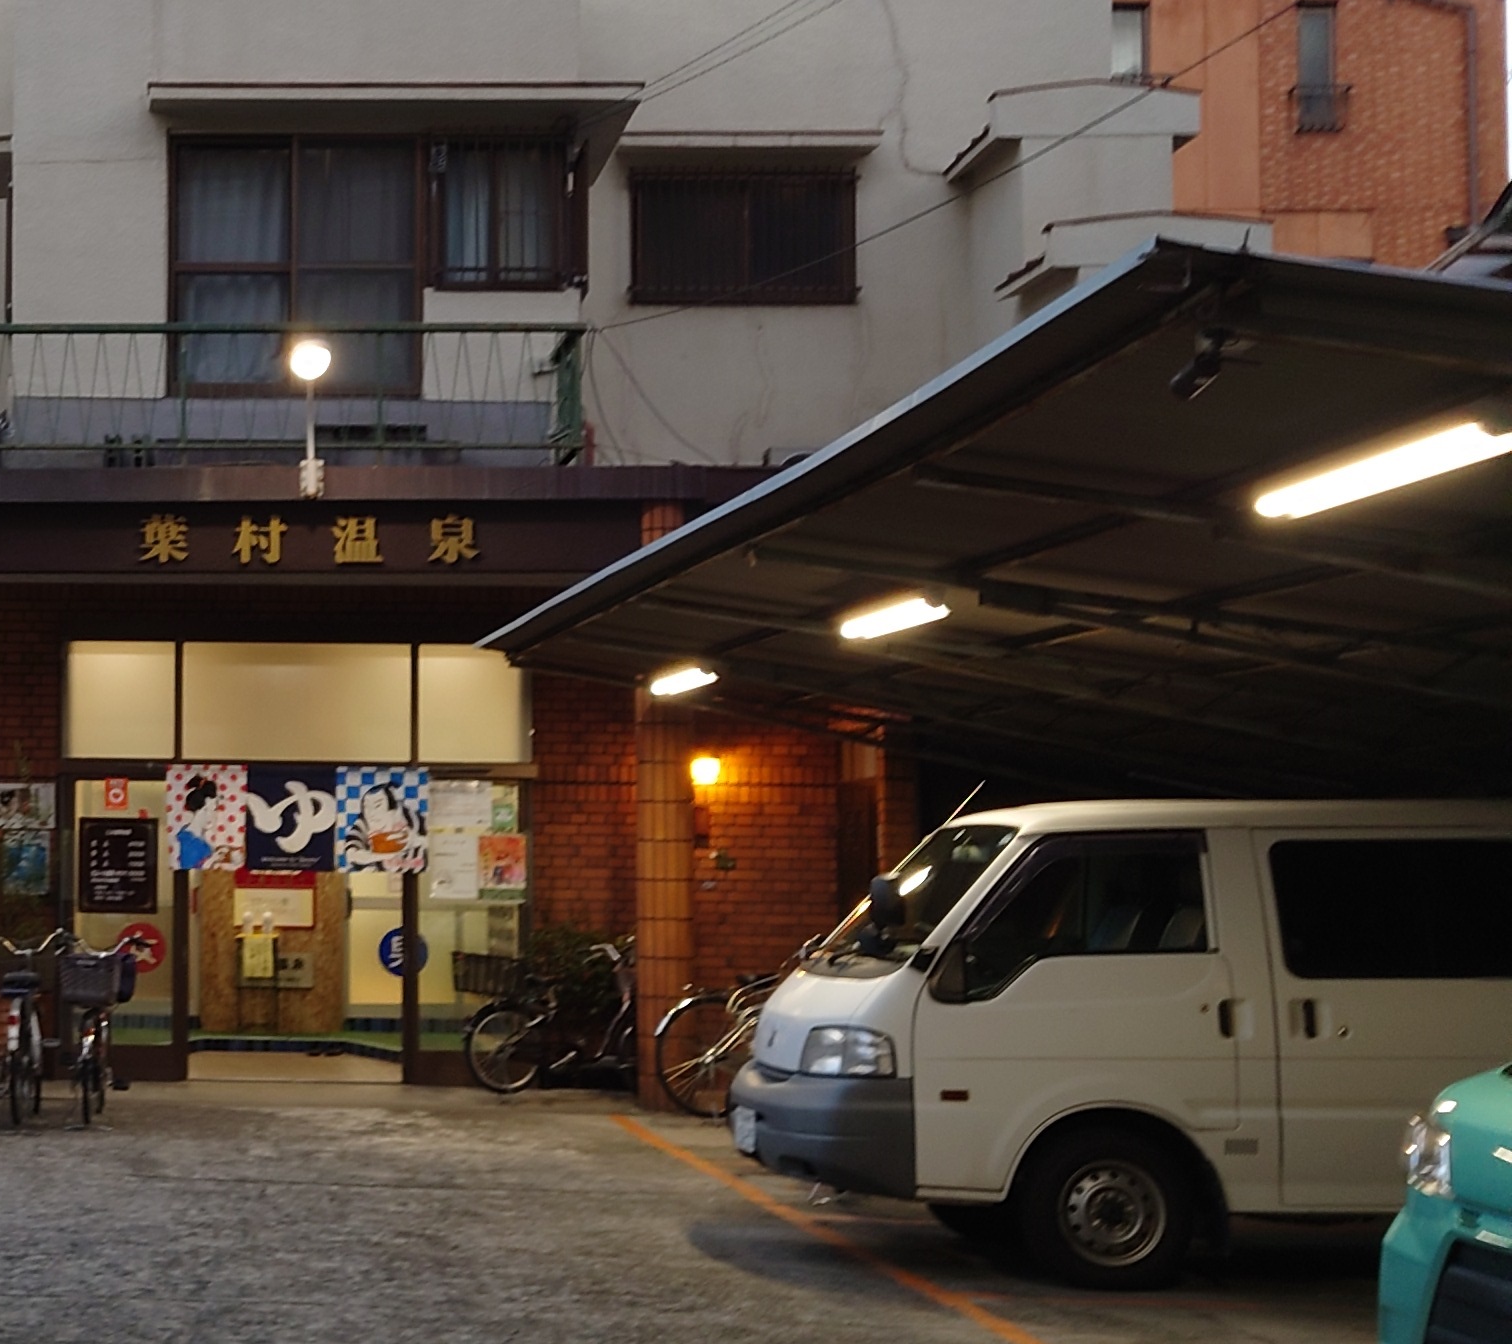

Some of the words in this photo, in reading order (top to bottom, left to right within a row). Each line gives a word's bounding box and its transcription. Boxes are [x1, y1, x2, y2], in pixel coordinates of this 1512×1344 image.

[139, 514, 480, 564] 葉村温泉
[247, 780, 336, 854] ゆ
